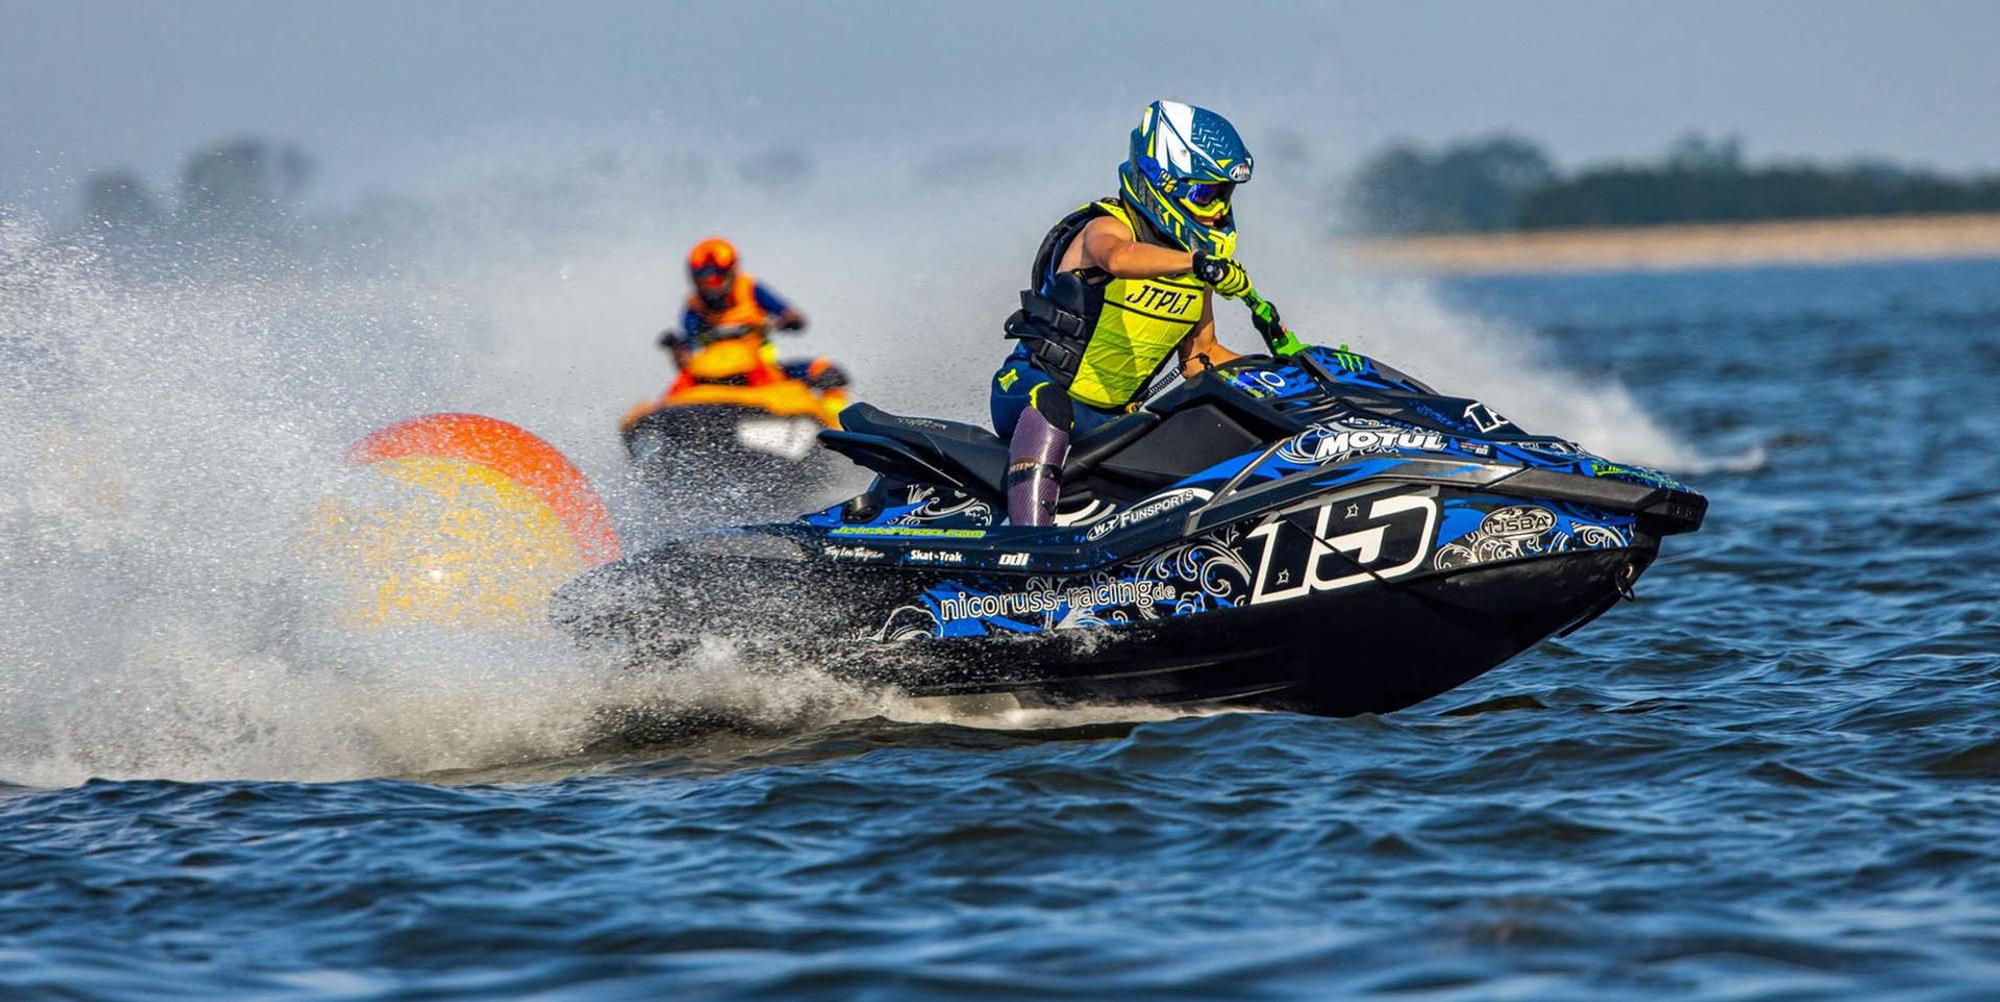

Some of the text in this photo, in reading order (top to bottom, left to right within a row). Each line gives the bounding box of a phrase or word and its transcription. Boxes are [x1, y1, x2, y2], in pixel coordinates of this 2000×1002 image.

[1126, 284, 1198, 315] JTPLT
[1315, 430, 1447, 460] MOTUL
[1488, 516, 1549, 534] IJSBA
[1246, 495, 1437, 605] 15
